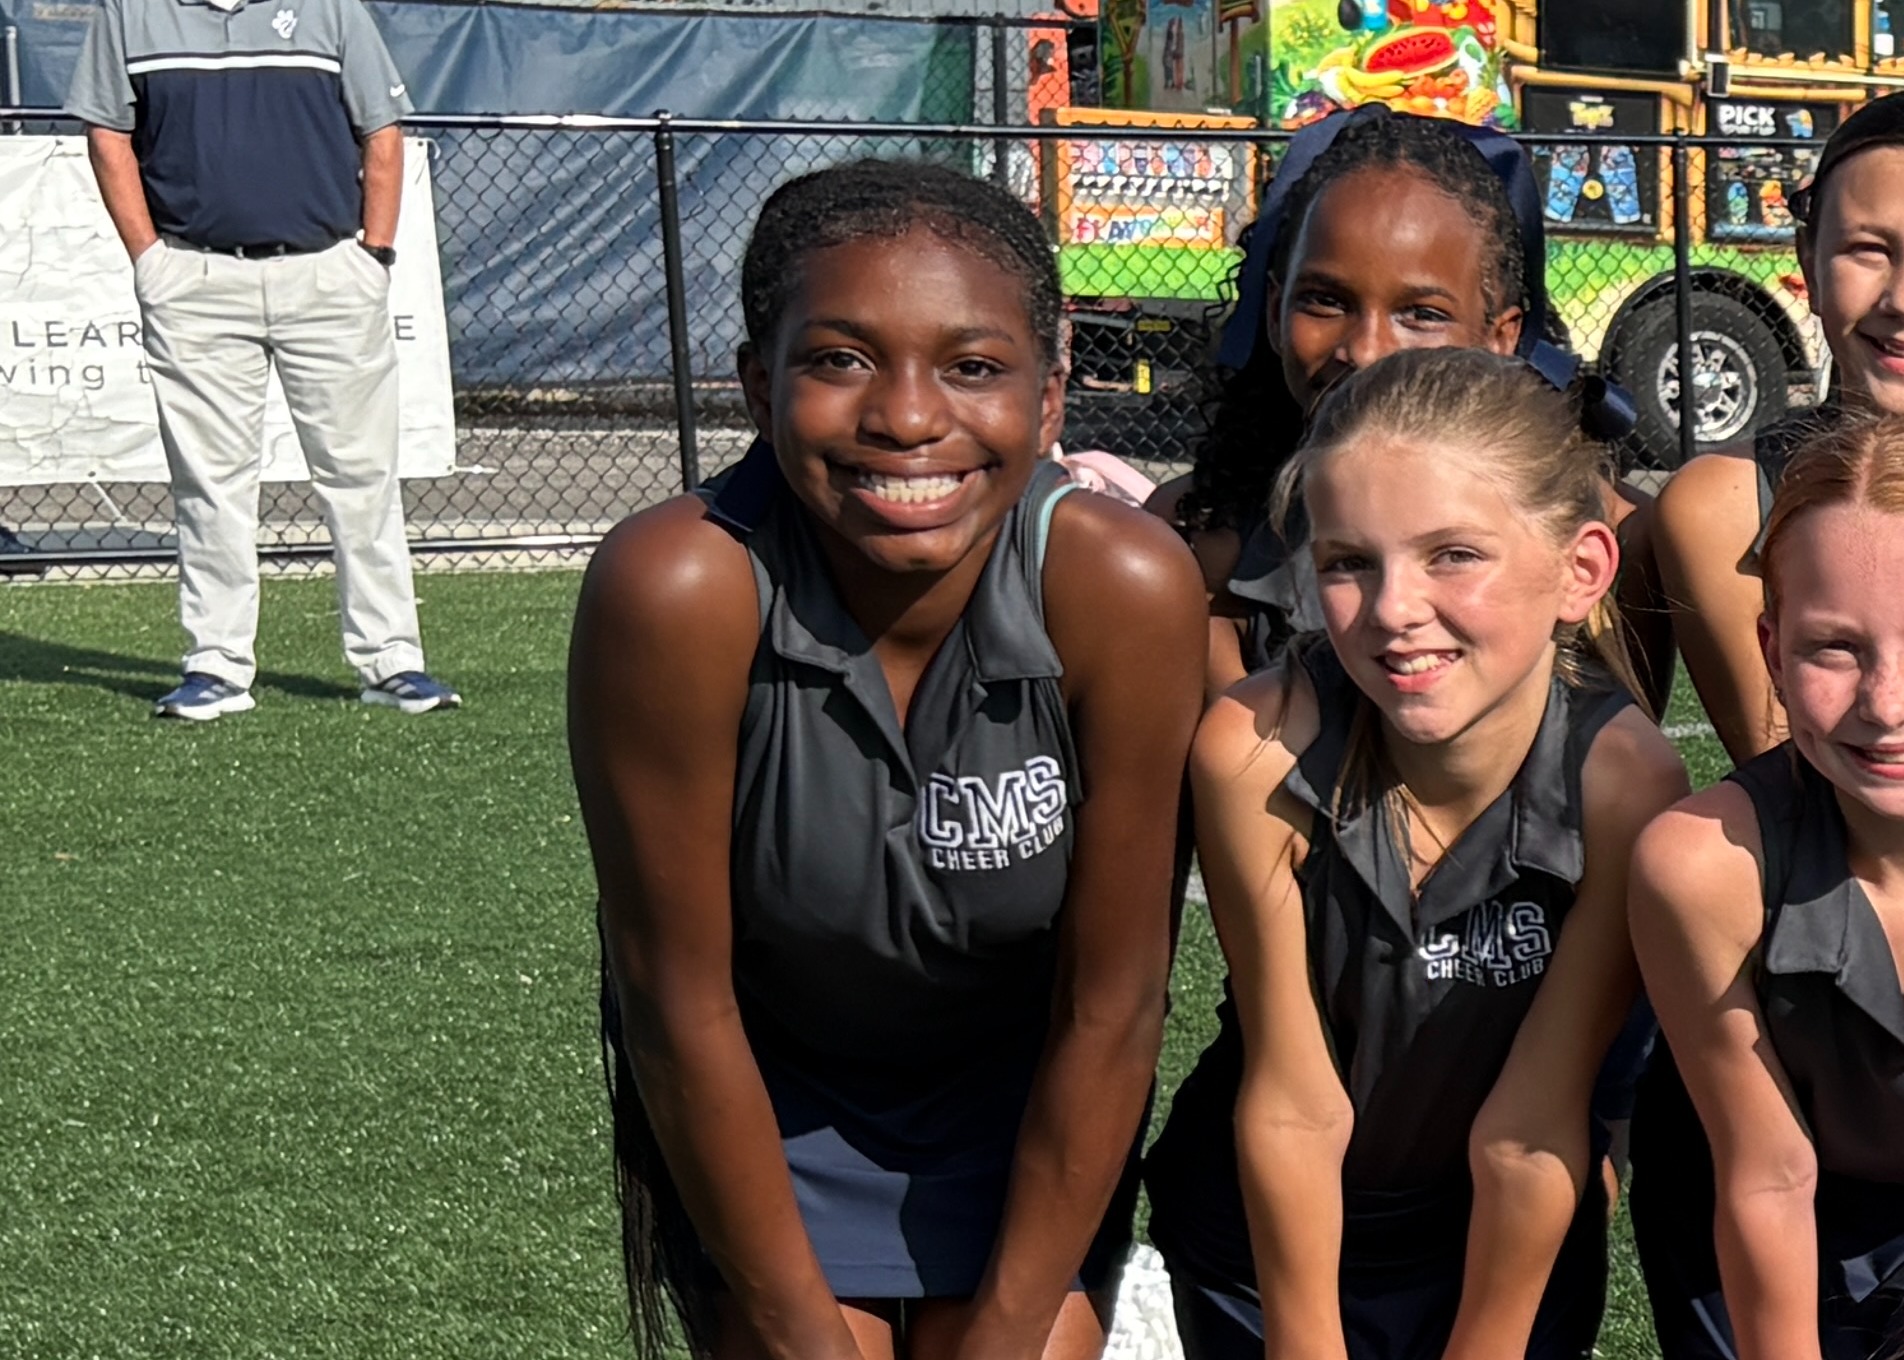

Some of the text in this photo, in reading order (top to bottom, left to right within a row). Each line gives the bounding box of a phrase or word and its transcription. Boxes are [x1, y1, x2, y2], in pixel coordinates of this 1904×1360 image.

[1718, 104, 1776, 126] PICK
[920, 754, 1068, 850] CMS
[932, 815, 1065, 871] CHEER CLUB
[1426, 957, 1545, 988] CHEER CLUB
